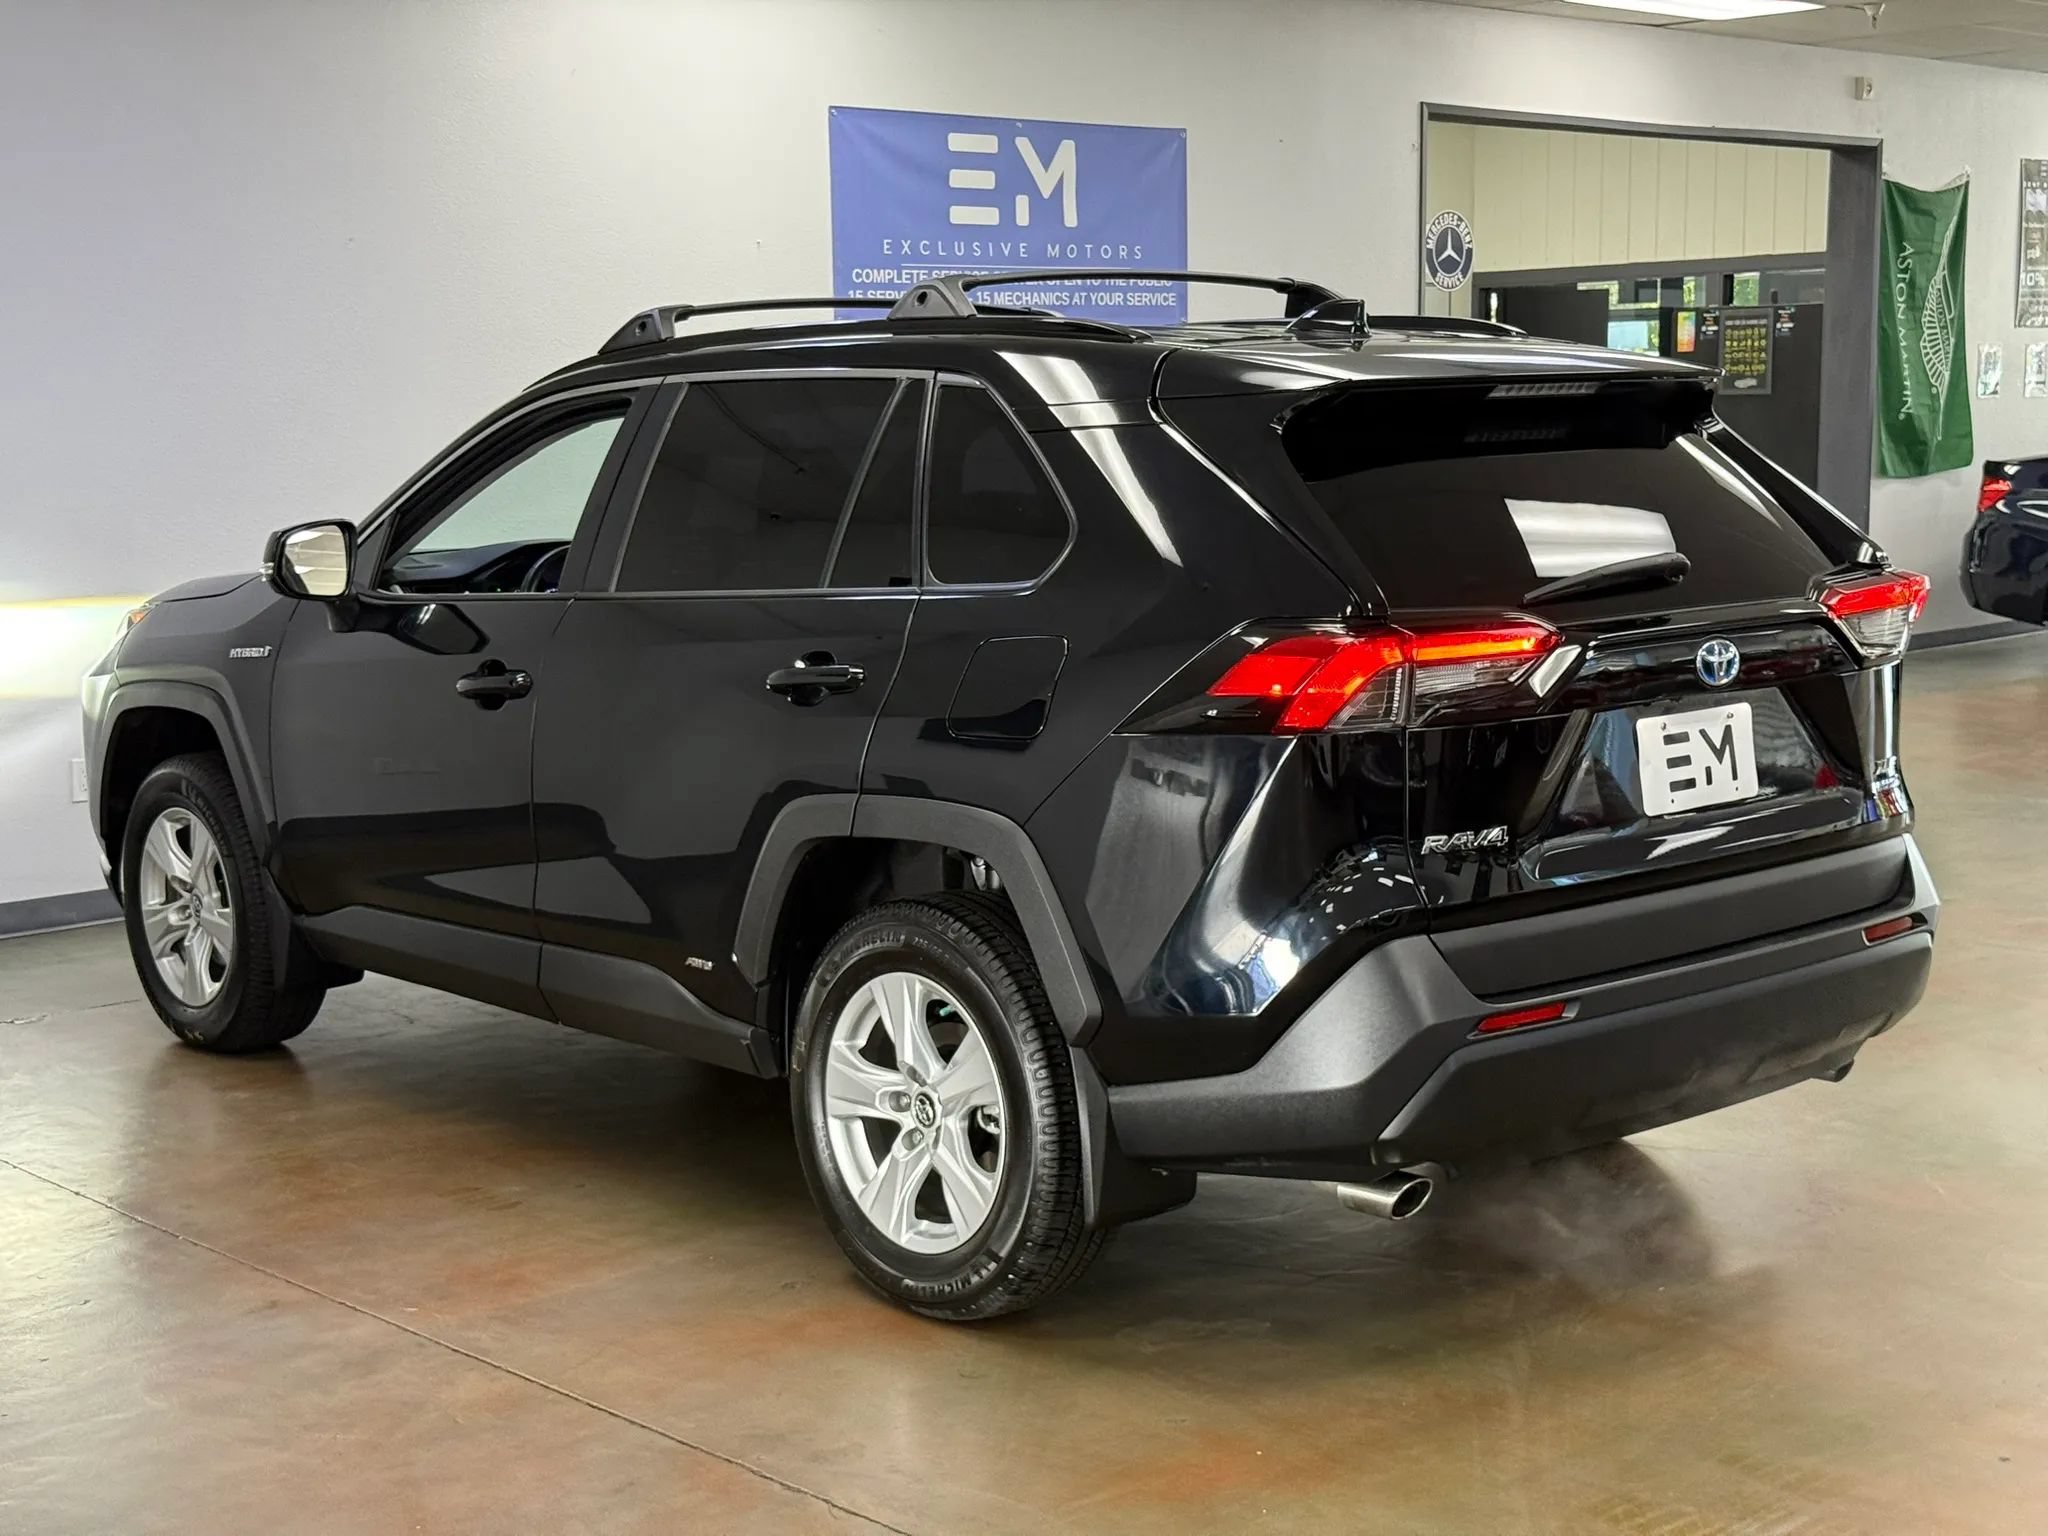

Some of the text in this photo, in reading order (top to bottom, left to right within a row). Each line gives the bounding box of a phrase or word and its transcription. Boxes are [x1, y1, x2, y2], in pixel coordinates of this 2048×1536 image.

[947, 132, 1078, 228] EM
[1426, 213, 1473, 249] MERCEDES-BENZ
[883, 239, 1143, 260] EXCLUSIVE MOTORS
[852, 268, 928, 284] COMPLETE
[1435, 271, 1464, 288] SERVICE
[1896, 242, 1915, 320] ASTON
[976, 291, 991, 305] 15
[993, 291, 1069, 306] MECHANICS
[1071, 292, 1086, 305] AT
[1090, 292, 1123, 306] YOUR
[1126, 292, 1177, 306] SERVICE
[1663, 724, 1738, 793] EM
[1420, 825, 1509, 855] RAV4
